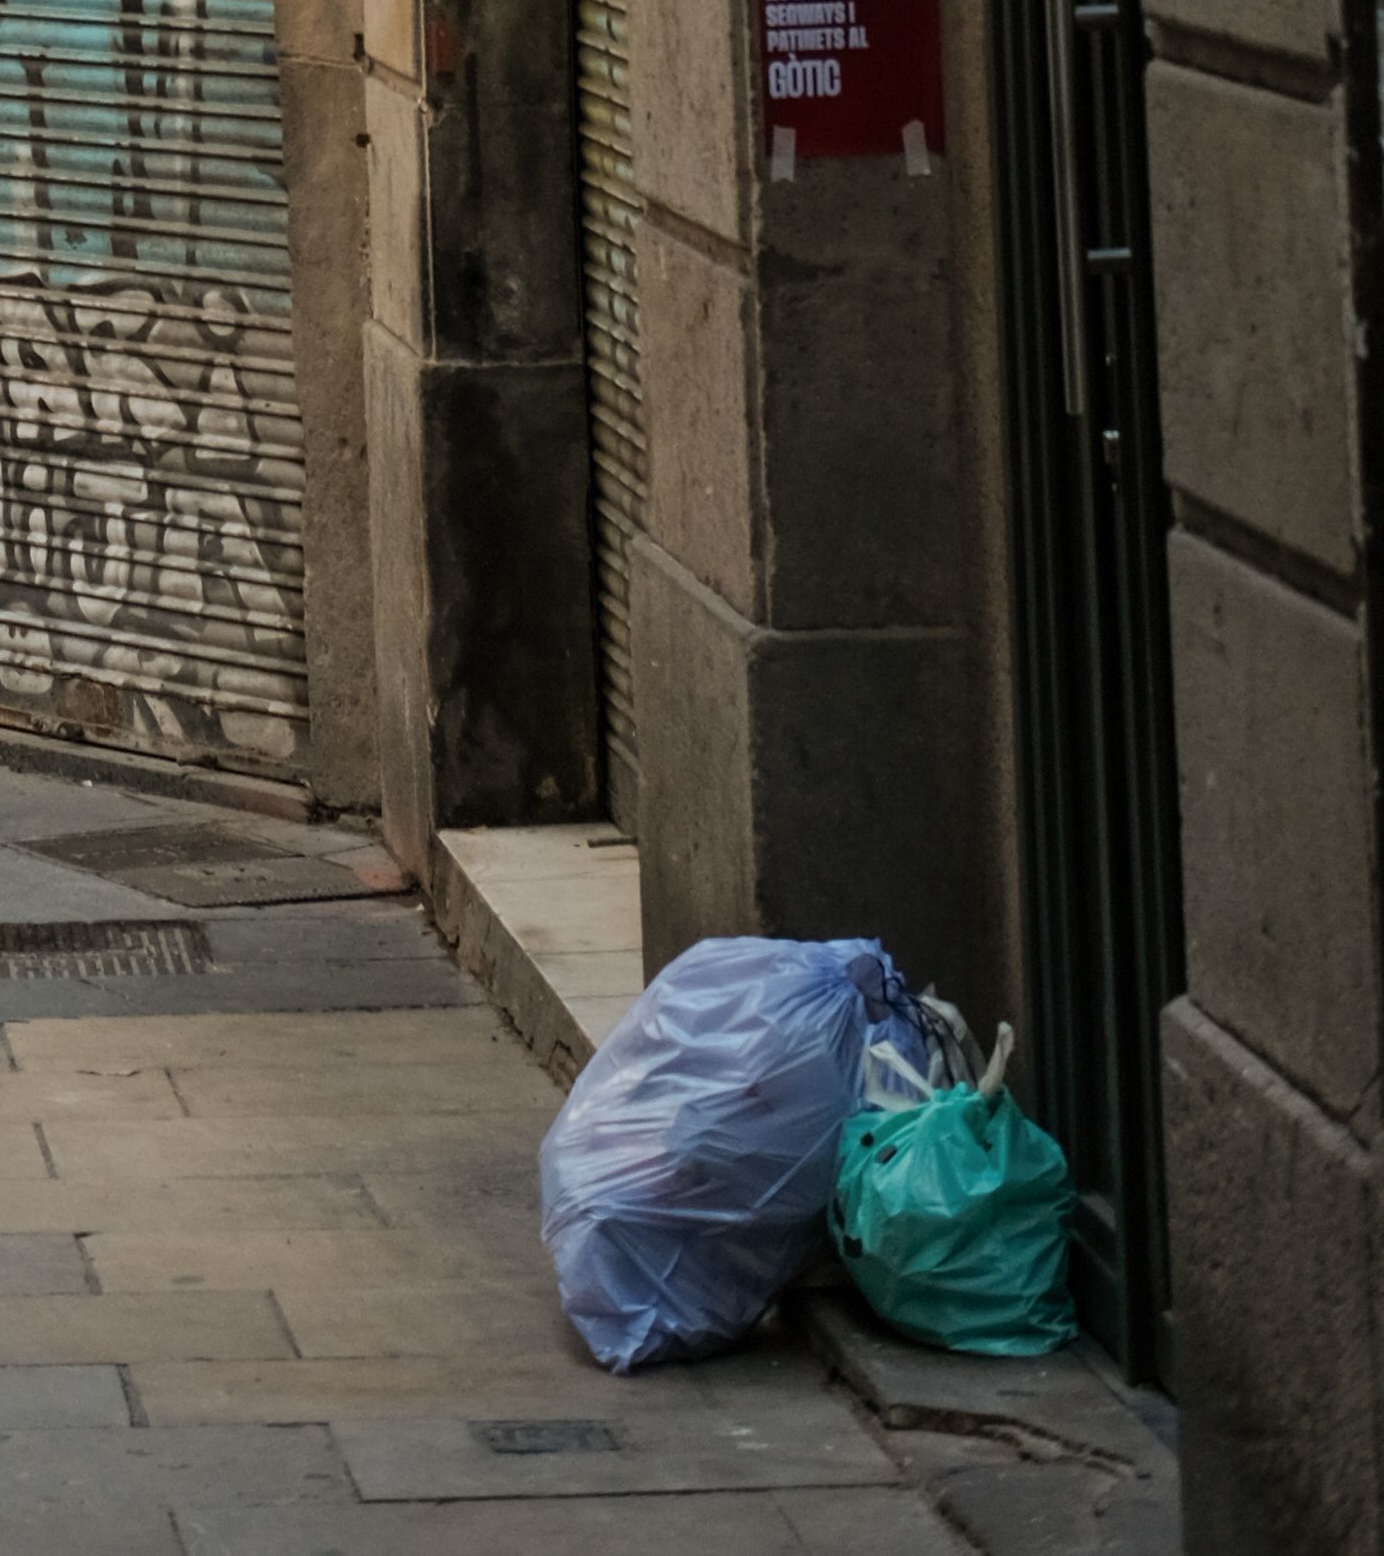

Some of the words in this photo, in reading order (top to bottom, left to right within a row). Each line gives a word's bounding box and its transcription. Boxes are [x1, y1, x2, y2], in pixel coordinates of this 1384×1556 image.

[765, 1, 846, 27] SEGWAYS
[767, 27, 845, 52] PATINETS
[848, 26, 870, 48] AL
[768, 52, 841, 99] GÒTIC
